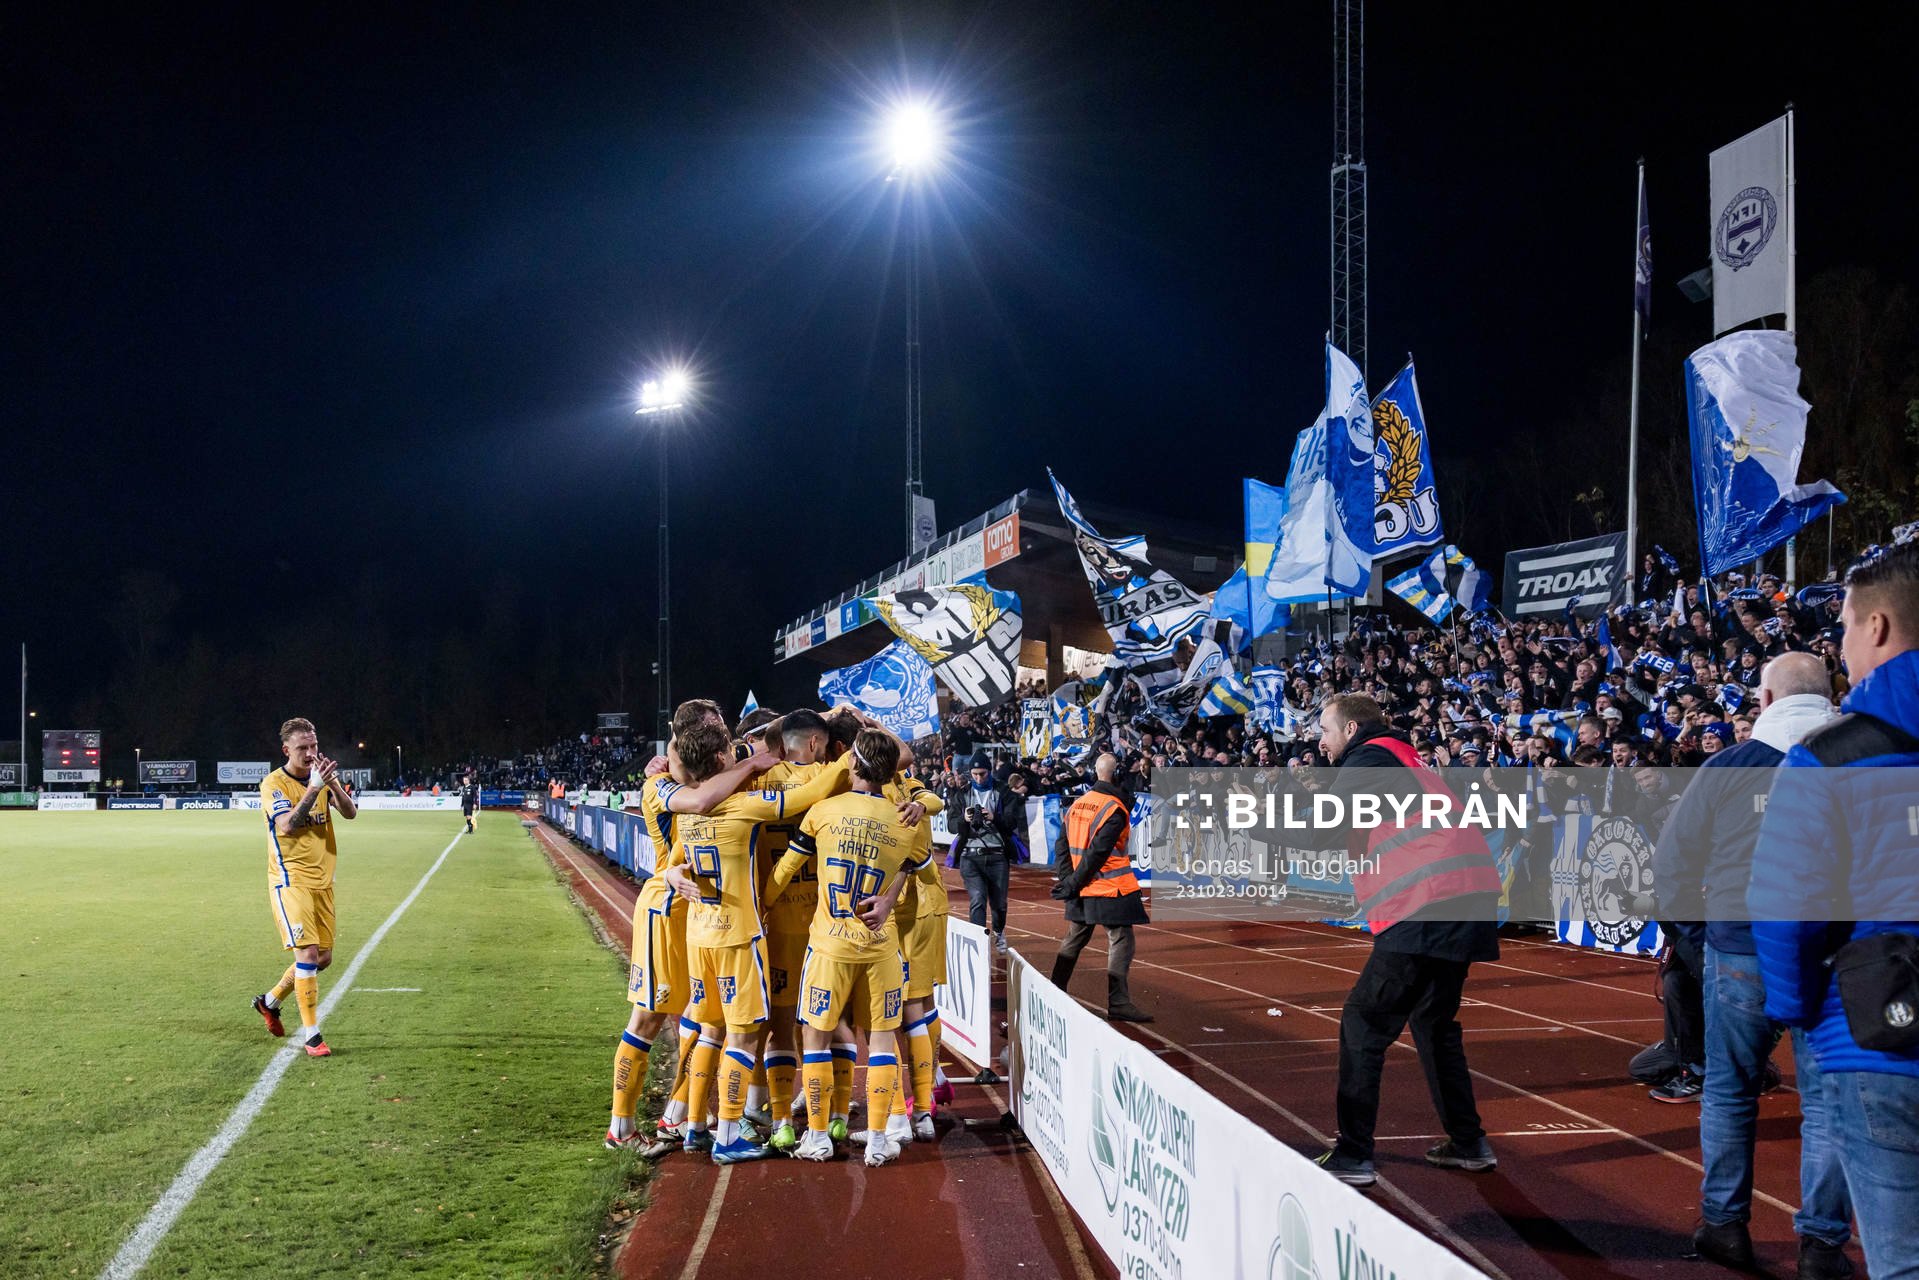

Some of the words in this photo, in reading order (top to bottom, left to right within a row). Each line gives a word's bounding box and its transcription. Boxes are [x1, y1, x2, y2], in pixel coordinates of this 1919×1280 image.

[987, 520, 1013, 552] ramo
[1518, 565, 1614, 597] TROAX
[57, 771, 83, 780] BYGGA
[235, 766, 269, 776] sporda
[182, 800, 223, 810] golvabia
[841, 816, 889, 834] NORDIC
[829, 825, 898, 848] WELLNESS
